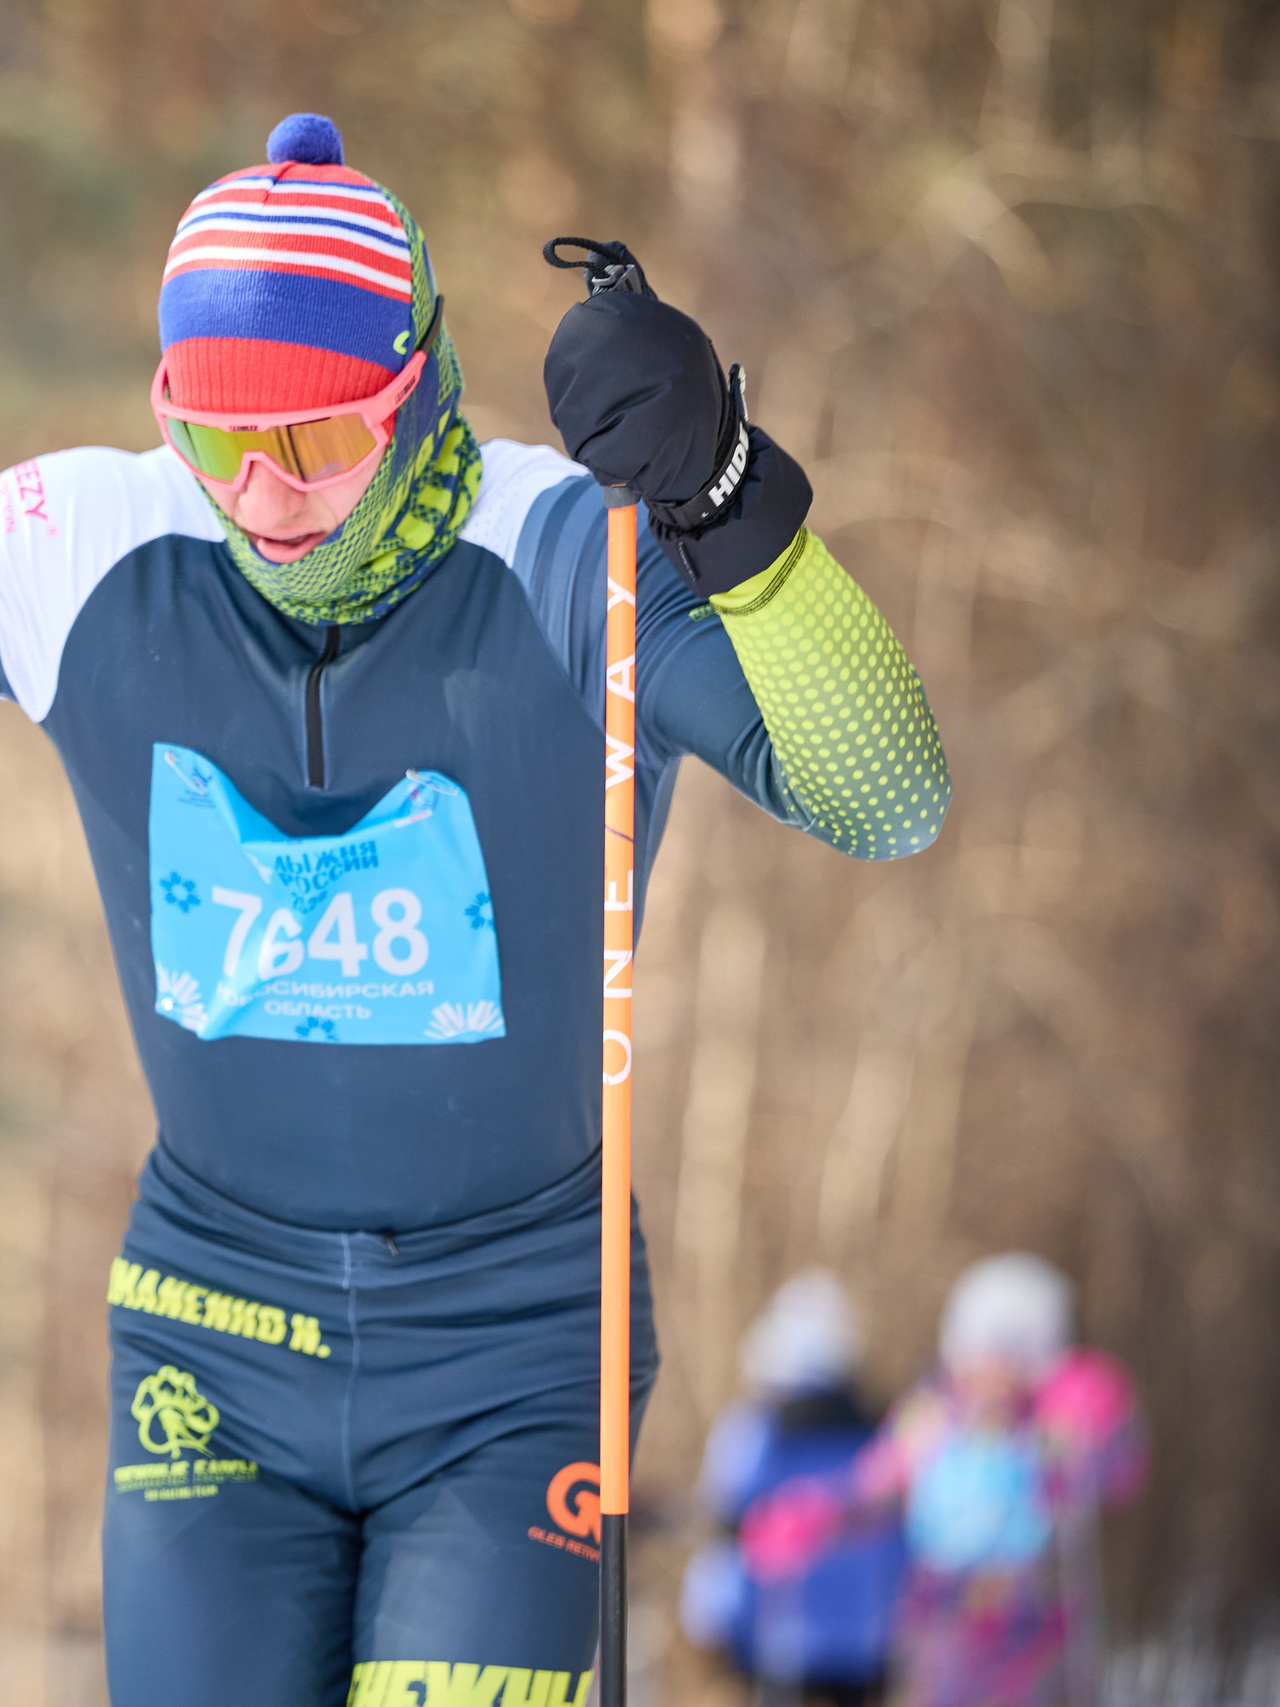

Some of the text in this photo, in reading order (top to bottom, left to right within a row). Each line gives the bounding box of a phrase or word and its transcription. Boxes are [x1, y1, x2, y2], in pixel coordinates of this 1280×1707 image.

[605, 576, 636, 790] WAY
[212, 887, 429, 981] 7648
[263, 1000, 372, 1020] ОБЛАСТЬ
